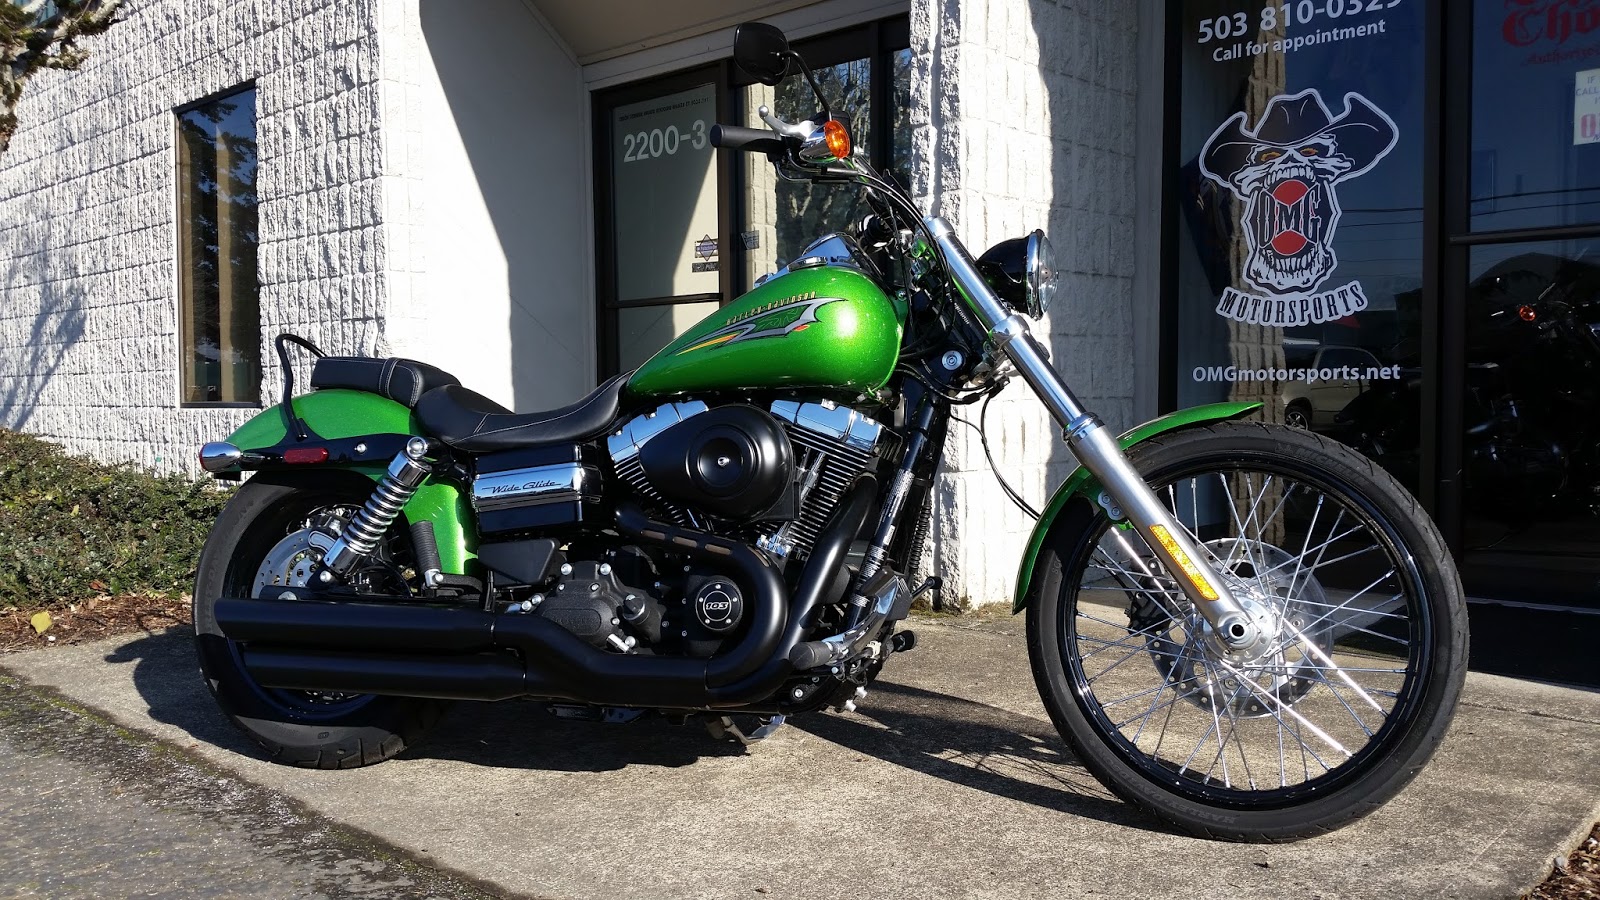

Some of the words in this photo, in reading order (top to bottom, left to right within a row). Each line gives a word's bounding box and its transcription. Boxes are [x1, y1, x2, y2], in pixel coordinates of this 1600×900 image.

[1198, 12, 1248, 44] 503
[1213, 43, 1242, 62] Call
[1246, 41, 1269, 57] for
[1273, 19, 1386, 53] appointment
[623, 119, 706, 163] 2200-3
[1258, 183, 1322, 249] OMG
[1219, 283, 1366, 324] MOTORSPORTS
[1192, 364, 1401, 385] OMGmotorsports.net
[482, 484, 522, 494] Wide
[522, 480, 562, 490] Glide
[705, 601, 729, 611] 103
